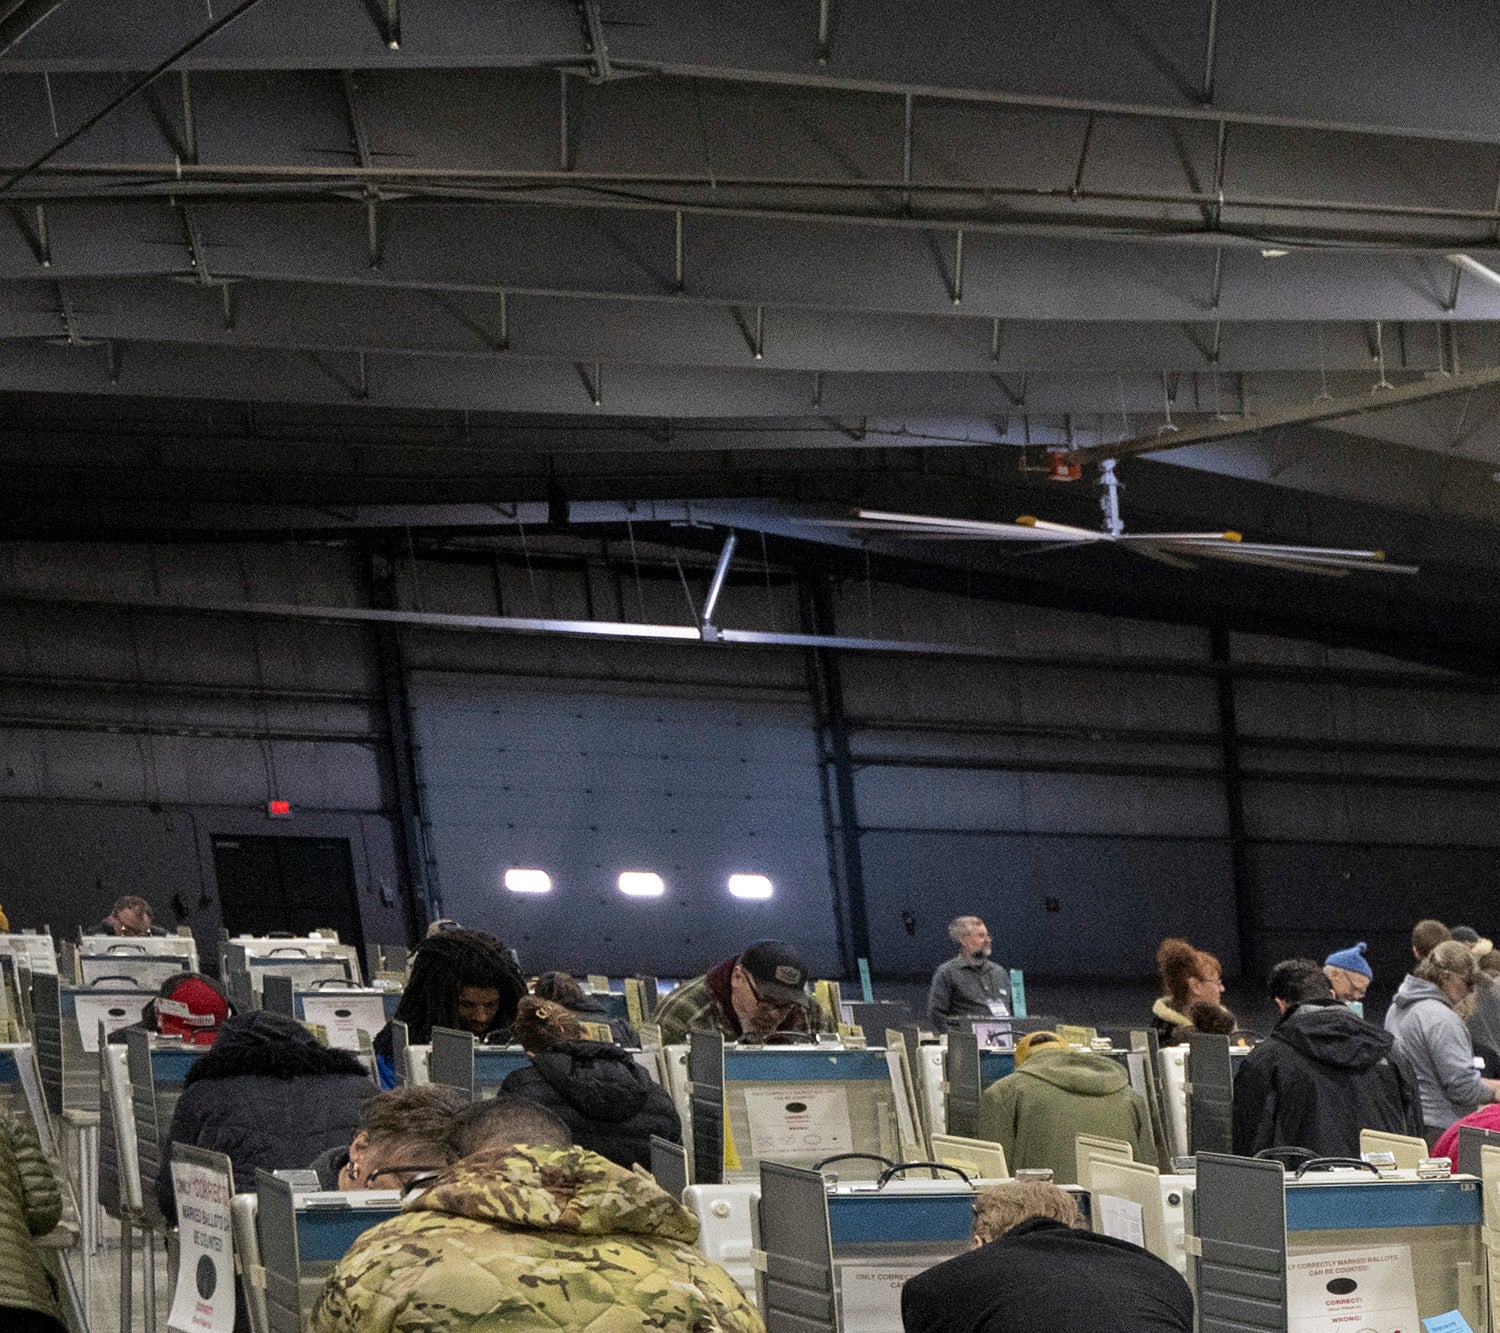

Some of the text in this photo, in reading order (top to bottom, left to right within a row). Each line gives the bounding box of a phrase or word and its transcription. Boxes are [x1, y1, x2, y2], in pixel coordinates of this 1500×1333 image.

[1297, 1260, 1336, 1269] CORRECTLY
[1338, 1257, 1366, 1266] MARKED
[1368, 1254, 1398, 1263] BALLOTS
[1325, 1298, 1362, 1306] CORRECT!
